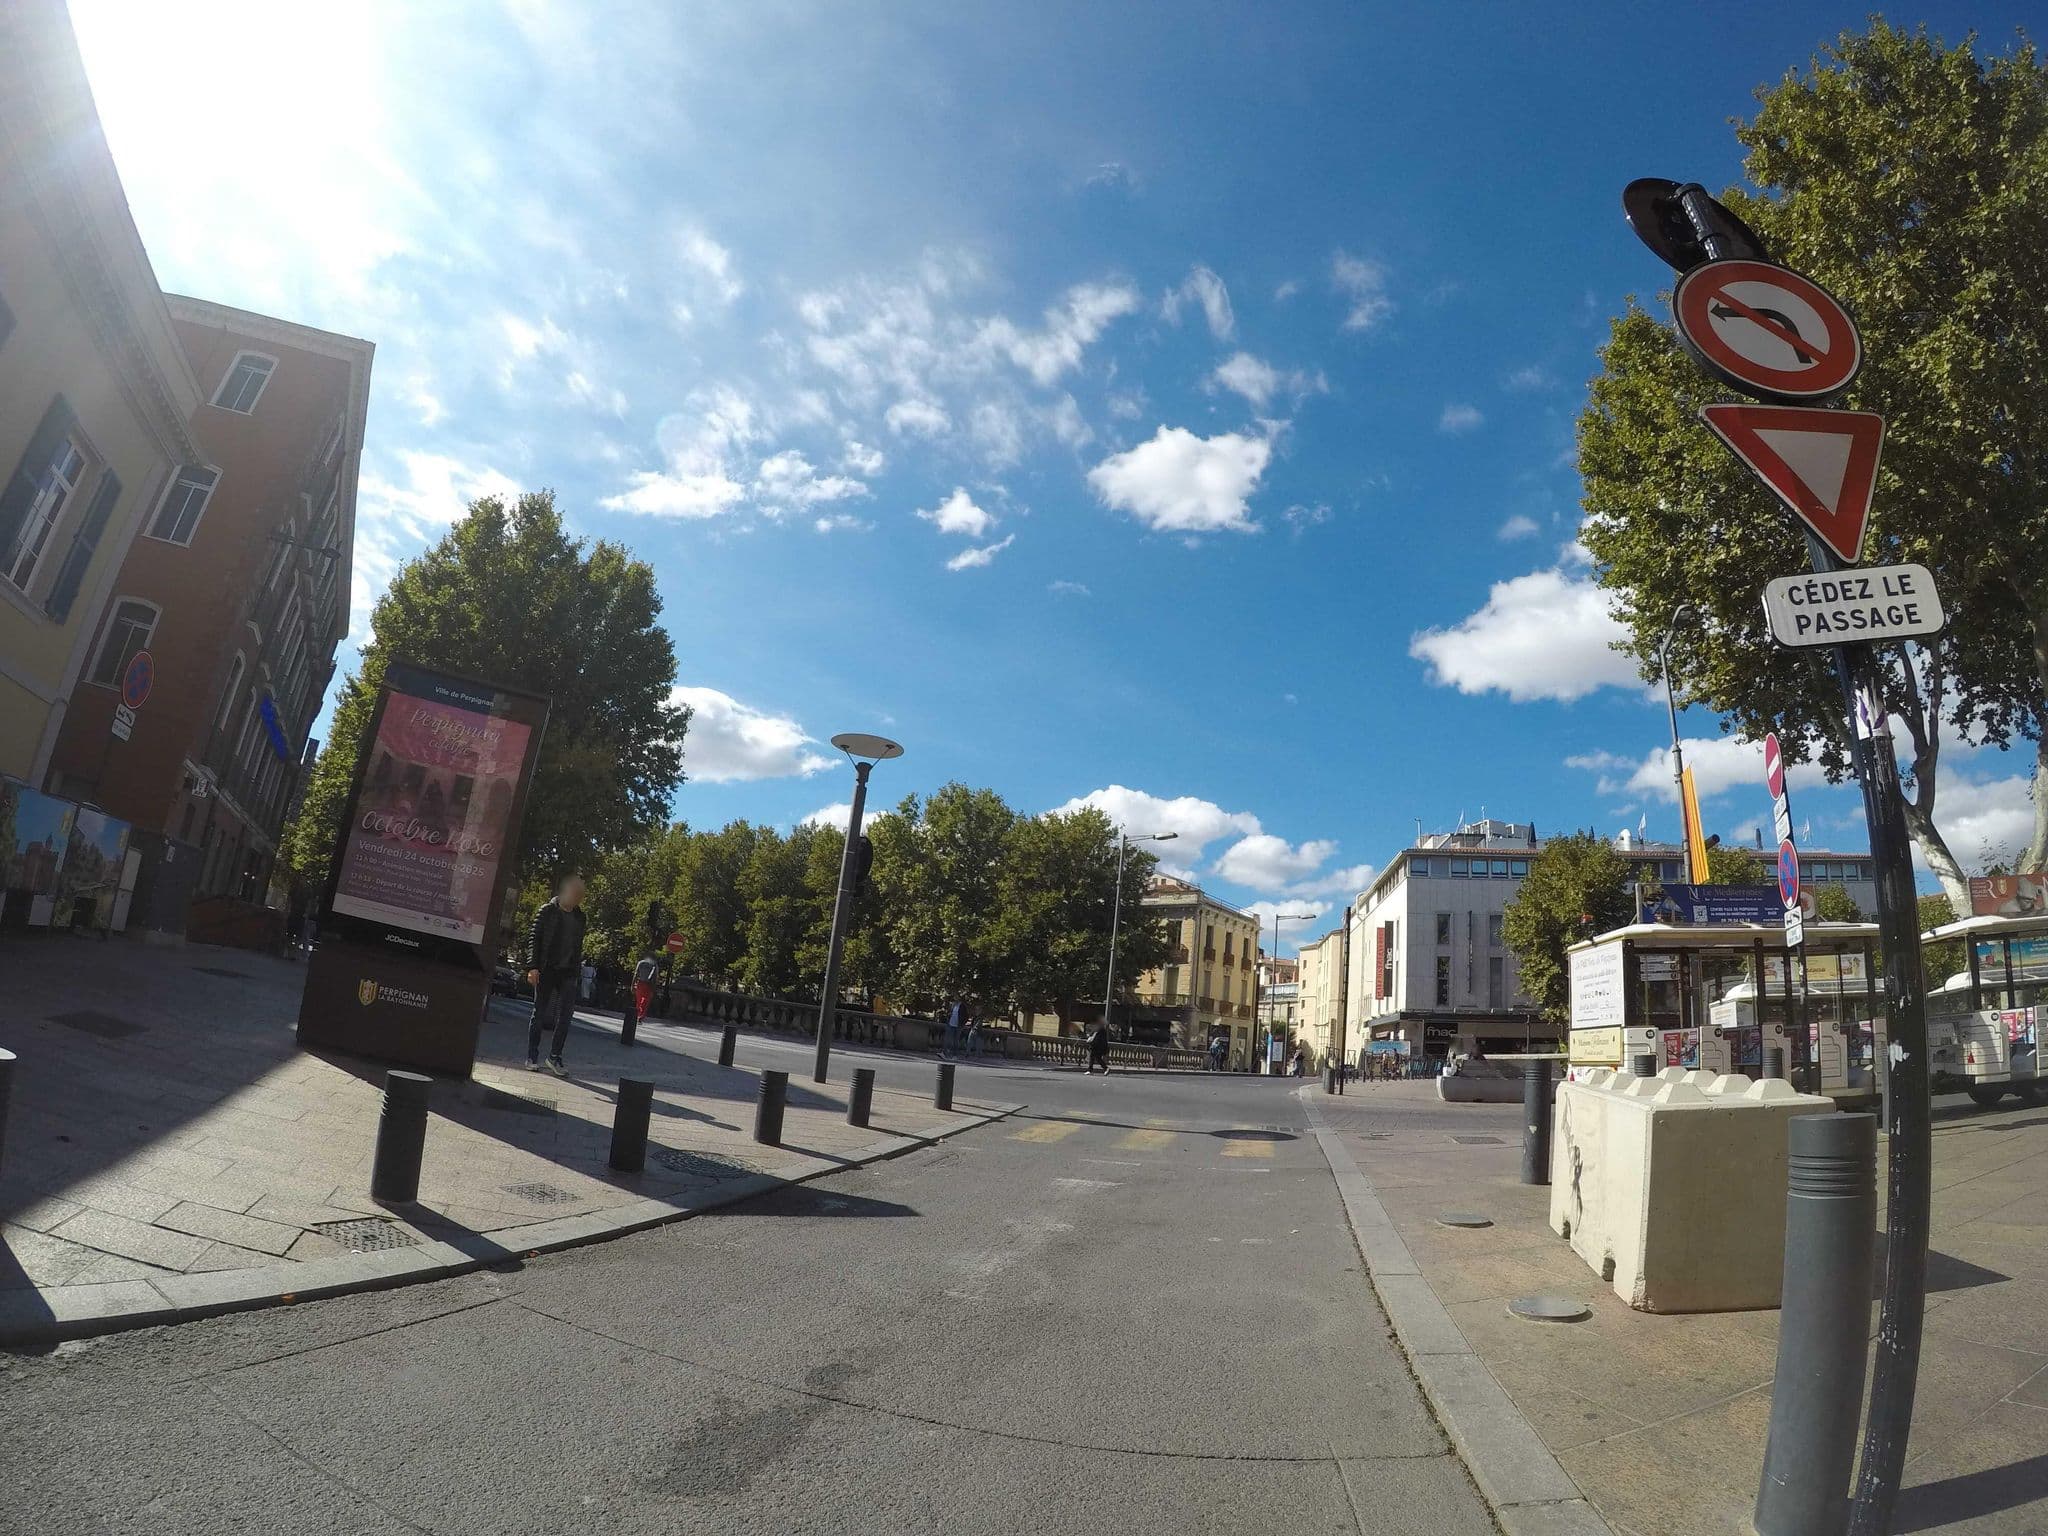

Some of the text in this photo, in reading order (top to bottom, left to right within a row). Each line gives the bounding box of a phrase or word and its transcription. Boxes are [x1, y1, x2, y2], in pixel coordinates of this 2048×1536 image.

[1787, 574, 1916, 606] CÉDEZ LE
[1795, 603, 1922, 636] PASSAGE
[435, 686, 495, 707] Ville de Perpignan
[361, 810, 495, 856] Octobre Rose
[359, 839, 402, 859] Vendredi
[403, 850, 417, 861] 24
[419, 854, 458, 871] octobre
[384, 934, 420, 948] JCDecaux
[1384, 947, 1393, 970] fnac
[378, 986, 429, 1003] PERPIGNAN
[1426, 1026, 1457, 1037] fnac
